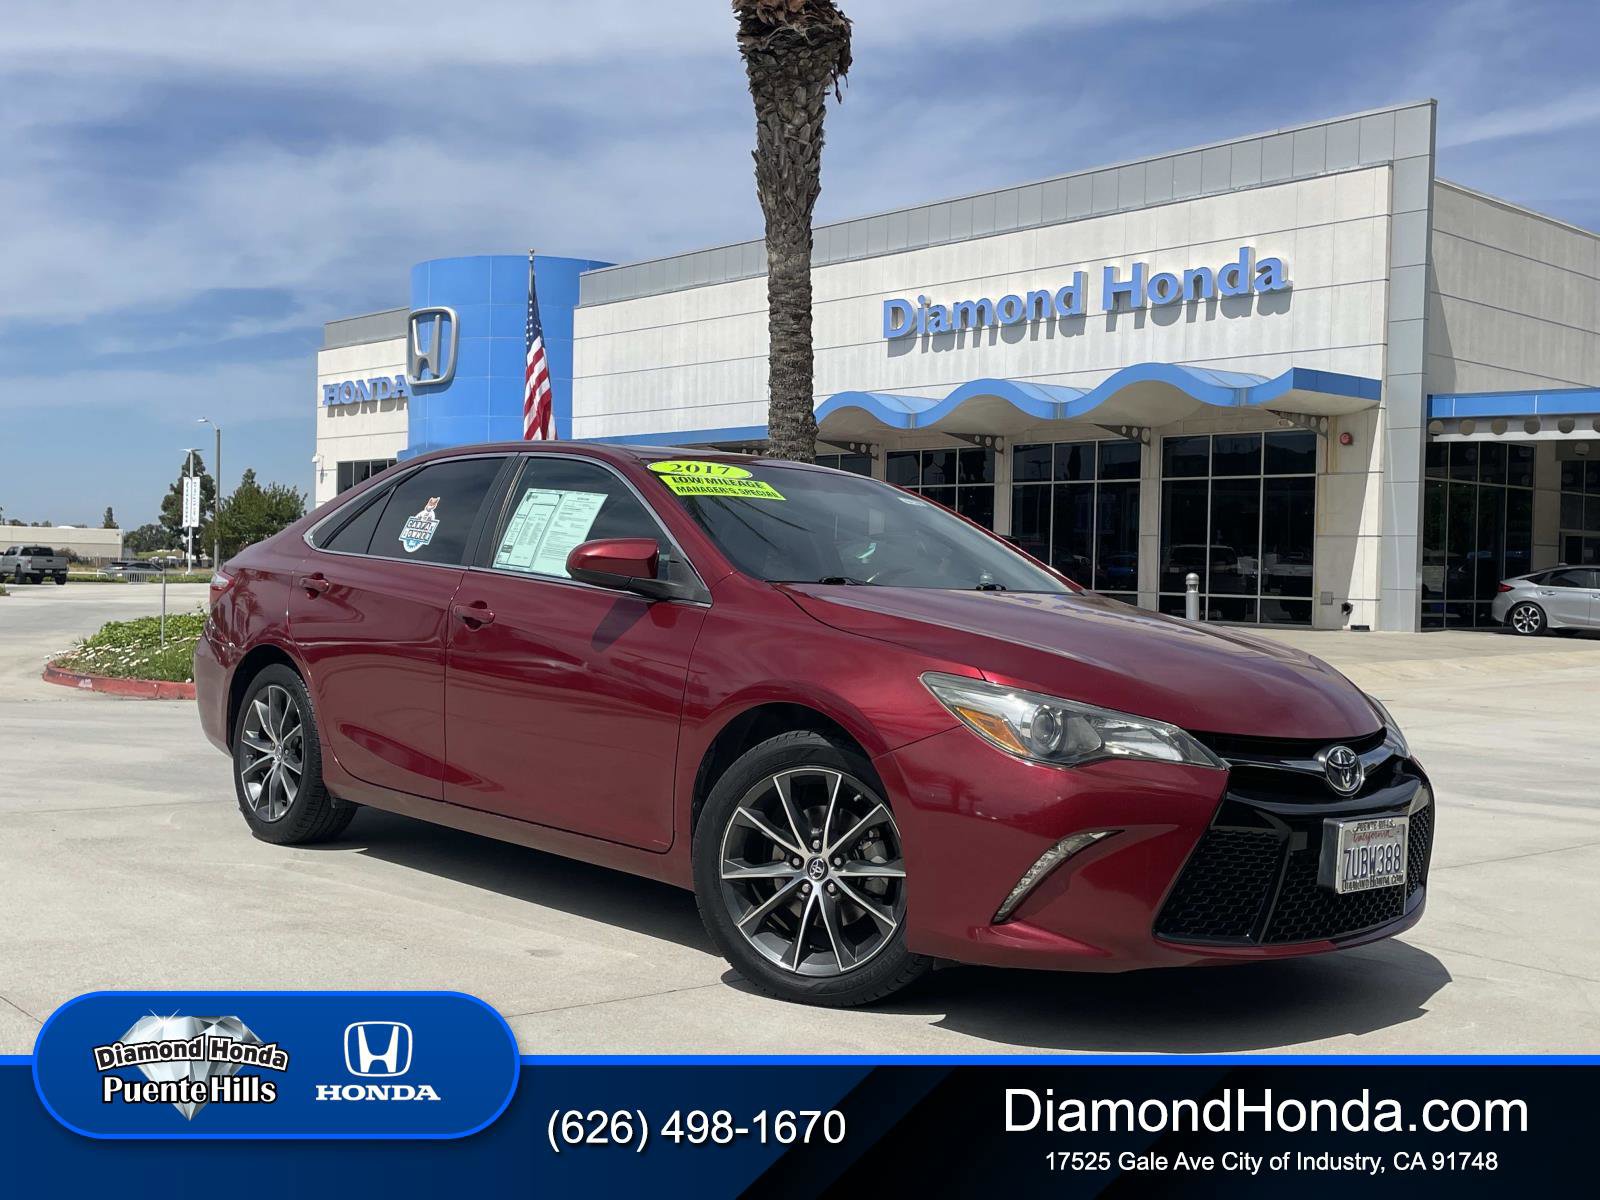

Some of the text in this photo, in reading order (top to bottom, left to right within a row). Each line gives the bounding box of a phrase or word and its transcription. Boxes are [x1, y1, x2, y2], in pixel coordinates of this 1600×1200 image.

[882, 245, 1293, 339] Diamond Honda
[322, 374, 411, 407] HONDA
[669, 463, 731, 475] 2017
[671, 476, 764, 489] LOW MILEAGE
[1343, 843, 1402, 881] 7UBW388
